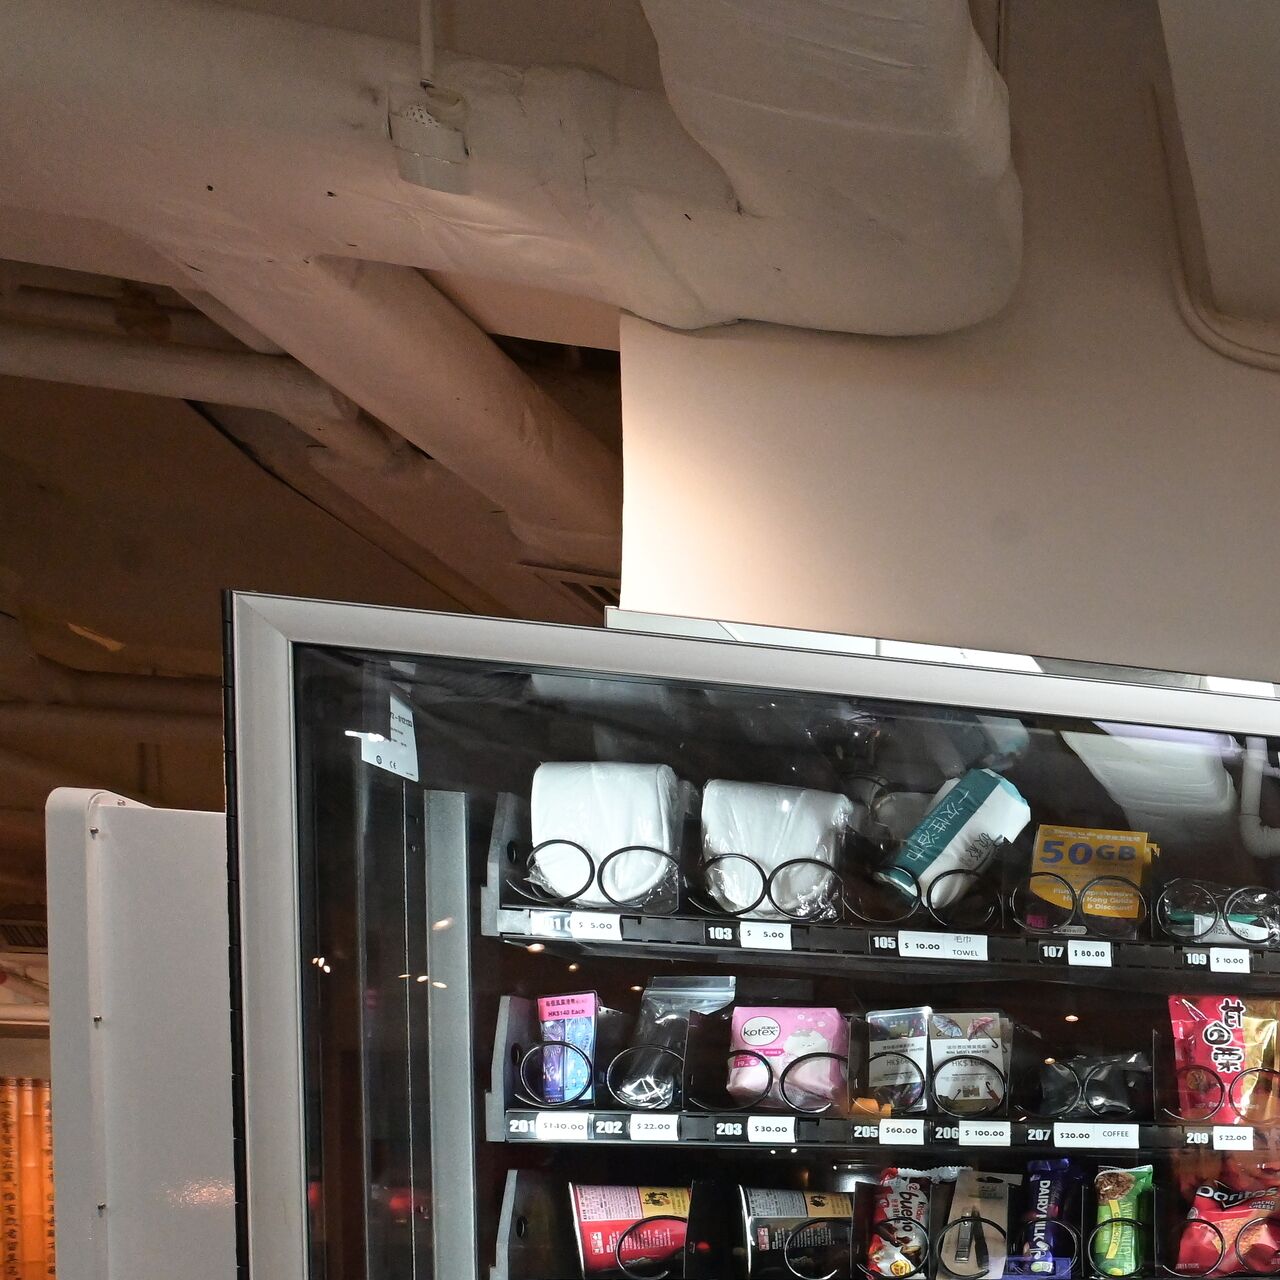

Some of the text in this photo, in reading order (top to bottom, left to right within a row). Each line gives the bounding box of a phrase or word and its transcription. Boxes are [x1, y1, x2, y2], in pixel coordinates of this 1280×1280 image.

[707, 927, 733, 940] 103
[873, 935, 896, 949] 105
[952, 949, 979, 957] TOWEL
[1042, 946, 1065, 958] 107
[1185, 953, 1207, 966] 109
[743, 1027, 776, 1036] kotex
[509, 1119, 535, 1133] 201
[595, 1120, 623, 1134] 202
[716, 1122, 742, 1136] 203
[854, 1126, 878, 1138] 205
[935, 1127, 959, 1140] 206
[1027, 1128, 1051, 1141] 207
[1102, 1130, 1129, 1138] COFFEE
[1036, 1180, 1051, 1215] DAIRY
[1195, 1186, 1279, 1201] Doritos
